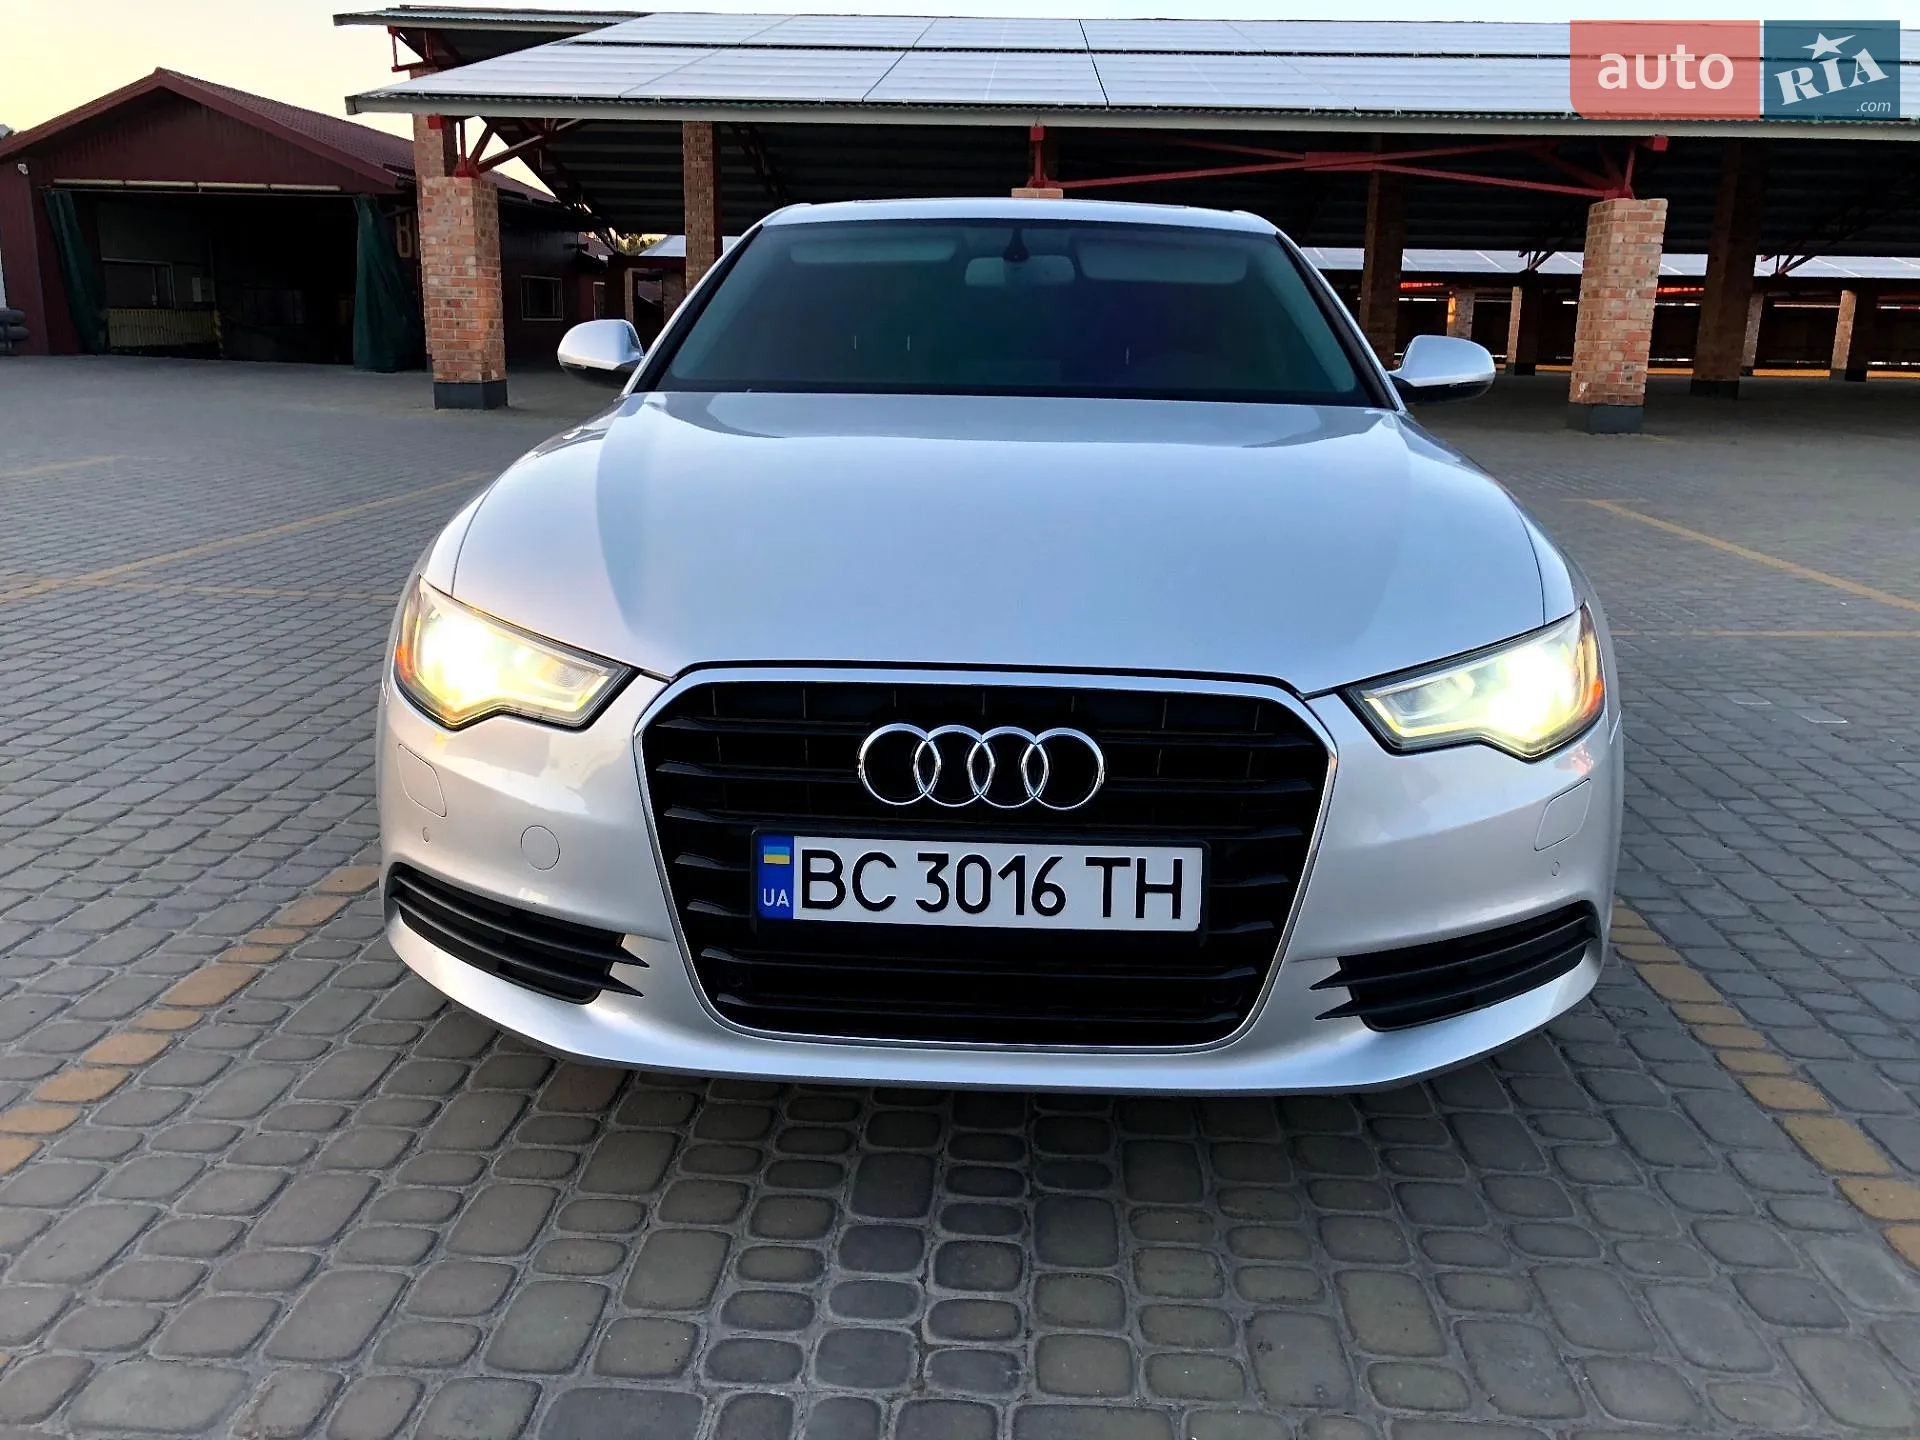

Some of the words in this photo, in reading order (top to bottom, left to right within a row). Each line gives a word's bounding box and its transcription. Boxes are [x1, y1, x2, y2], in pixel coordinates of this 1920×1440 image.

[763, 887, 790, 908] UA
[800, 848, 897, 912] BC
[915, 852, 1067, 918] 3016
[1085, 856, 1184, 920] TH
